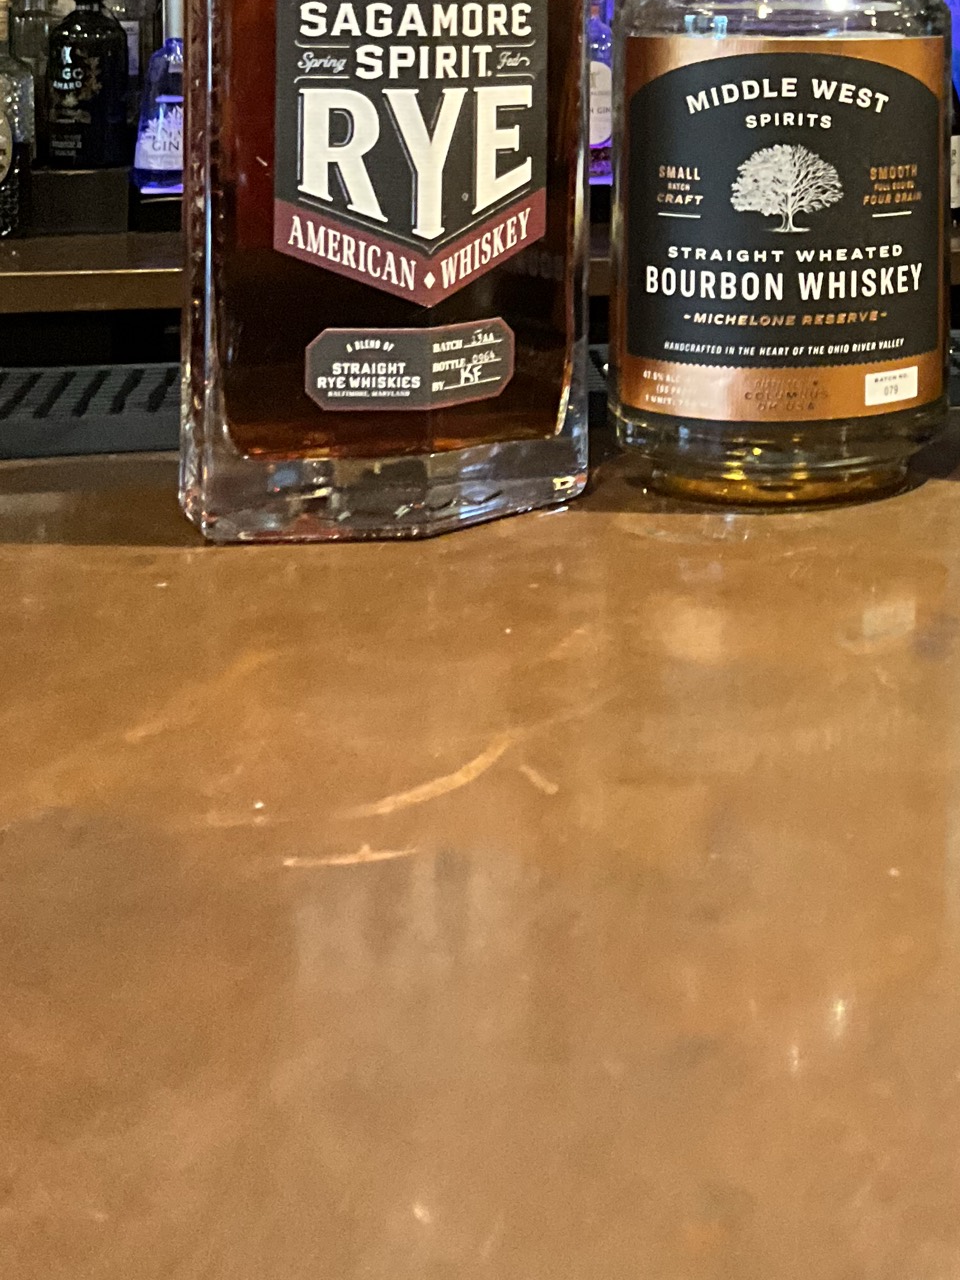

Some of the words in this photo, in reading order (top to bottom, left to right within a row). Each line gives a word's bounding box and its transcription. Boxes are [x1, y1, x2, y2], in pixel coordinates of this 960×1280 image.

[300, 1, 532, 37] SAGAMORE
[297, 52, 347, 73] Spring
[355, 44, 493, 80] SPIRIT
[497, 51, 531, 69] Fed
[53, 80, 82, 90] AMARO
[686, 77, 798, 115] MIDDLE
[812, 78, 889, 114] WEST
[745, 112, 832, 129] SPIRITS
[152, 141, 180, 152] GIN
[298, 85, 532, 240] RYE
[659, 165, 701, 180] SMALL
[870, 164, 918, 180] SMOOTH
[668, 182, 690, 191] BATCH
[657, 193, 704, 205] CRAFT
[863, 193, 892, 206] FOUR
[288, 215, 417, 291] AMERICAN
[440, 207, 531, 289] WHISKEY
[668, 246, 784, 263] STRAIGHT
[796, 244, 903, 263] WHEATED
[646, 265, 784, 301] BOURBON
[798, 262, 923, 301] WHISKEY
[354, 339, 380, 350] BLEND
[432, 339, 463, 353] BATCH
[664, 340, 722, 355] HANDCRAFTED
[725, 346, 735, 355] IN
[738, 346, 755, 356] THE
[759, 346, 789, 356] HEART
[792, 346, 805, 356] OF
[808, 345, 825, 355] THE
[827, 344, 850, 354] OHIO
[852, 341, 877, 352] RIVER
[878, 337, 905, 350] VALLEY
[332, 362, 406, 375] STRAIGHT
[432, 358, 466, 373] BOTTLE
[317, 376, 346, 389] RYE
[349, 376, 421, 389] WHISKIES
[432, 381, 445, 392] BY
[875, 375, 897, 383] BATCH
[884, 384, 899, 396] 079
